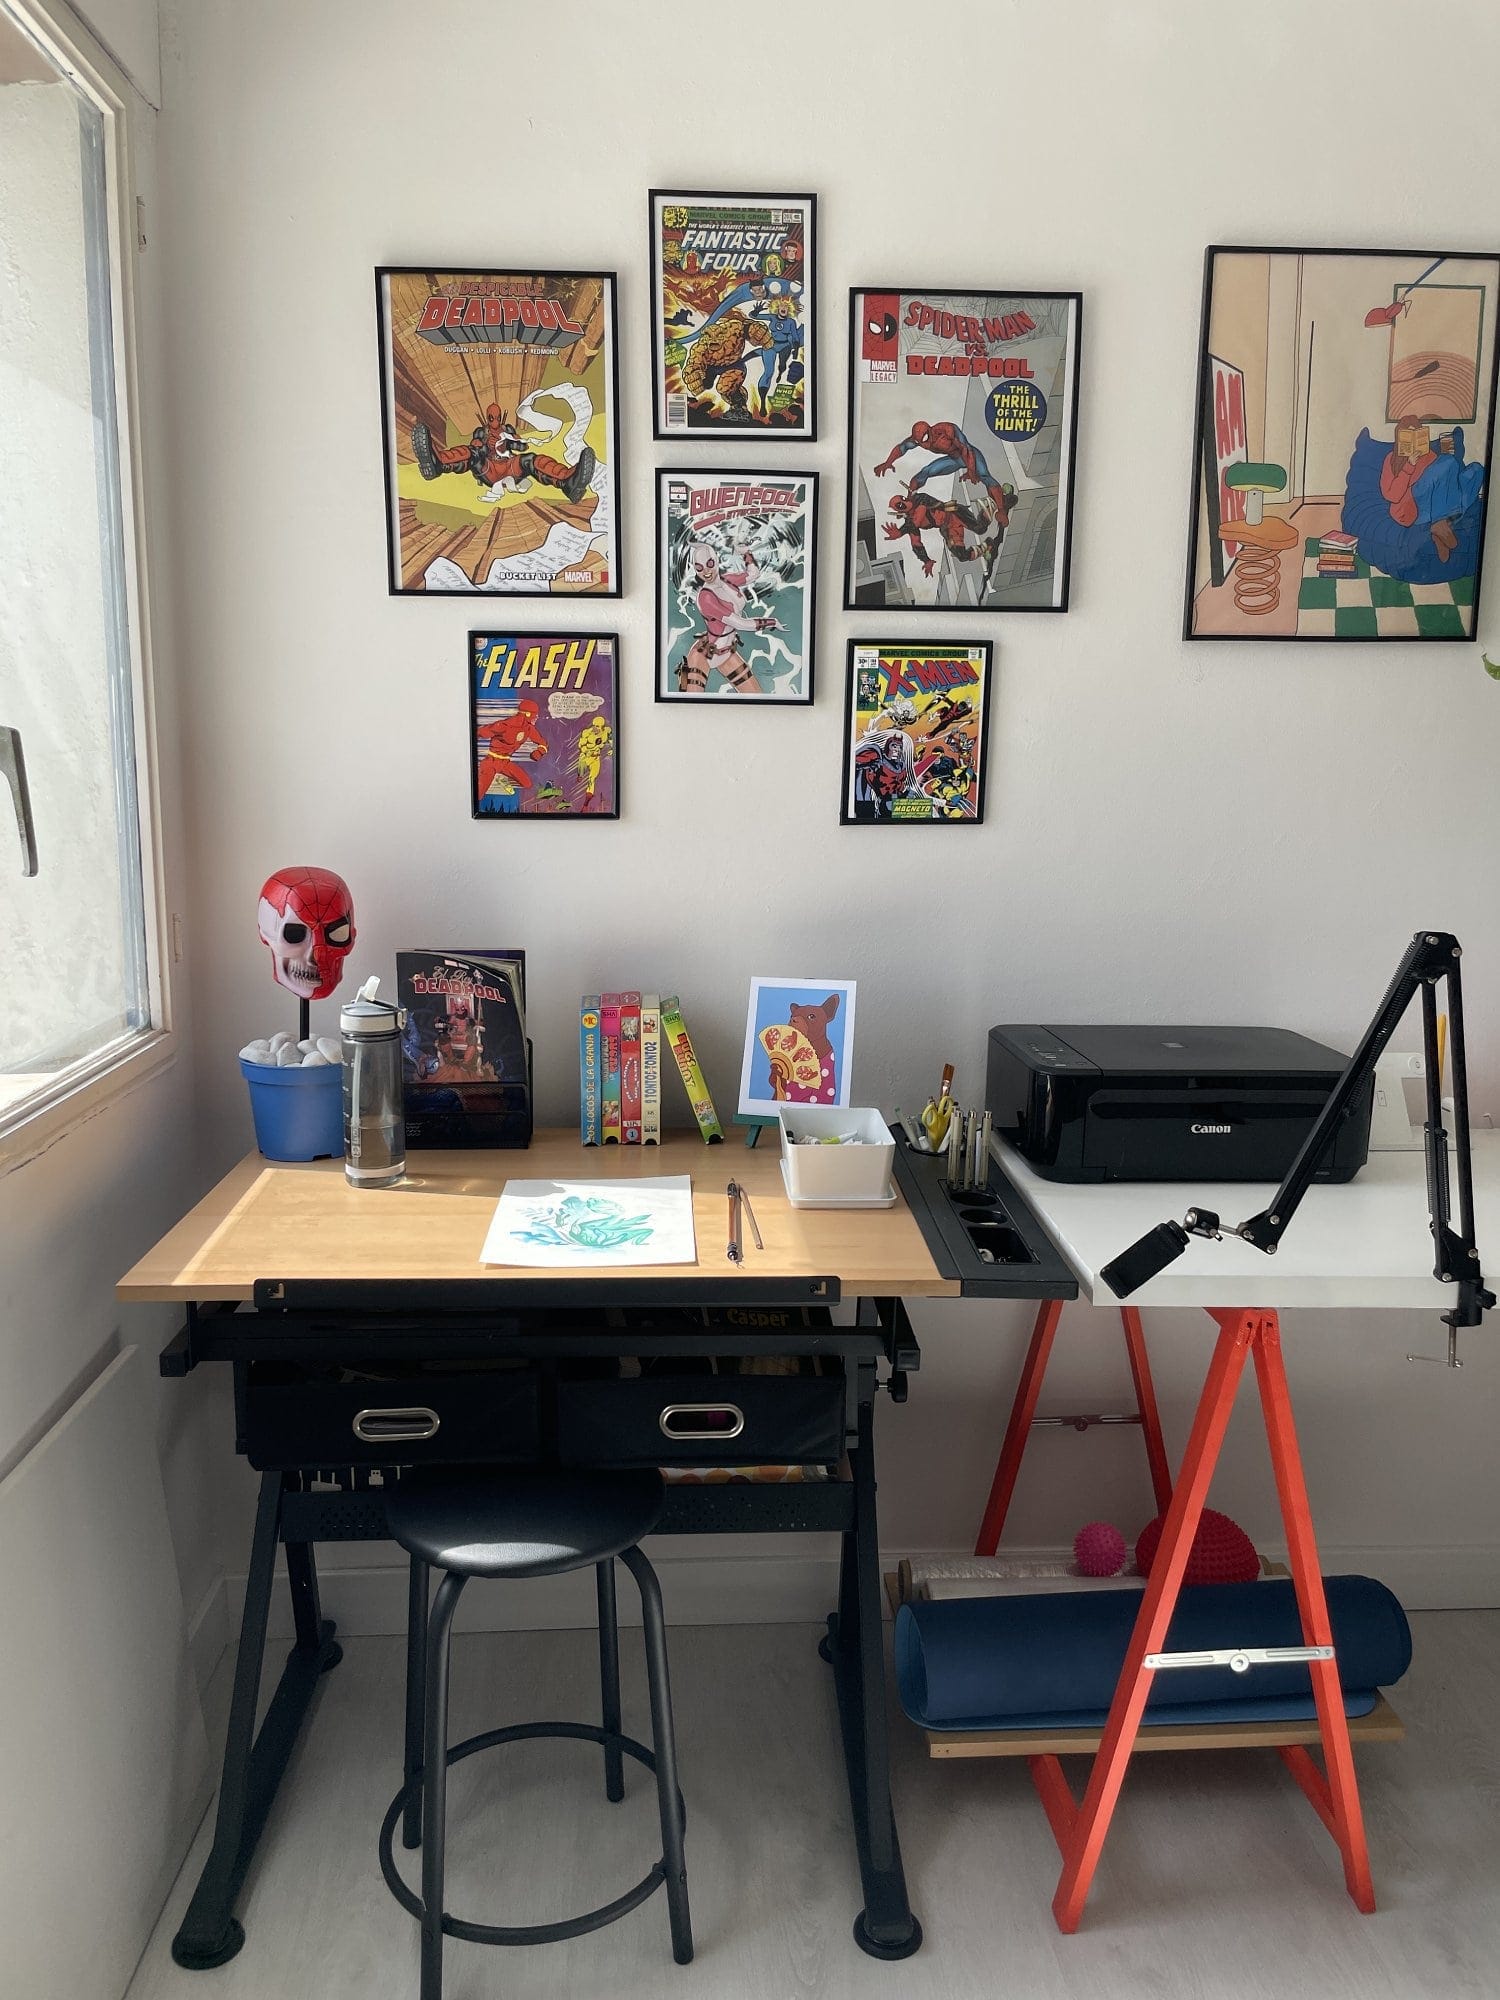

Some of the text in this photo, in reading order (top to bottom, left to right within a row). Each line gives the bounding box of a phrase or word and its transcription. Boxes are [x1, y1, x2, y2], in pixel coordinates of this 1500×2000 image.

[680, 229, 788, 251] FANTASTIC
[700, 251, 760, 272] FOUR
[459, 281, 544, 297] DESPICABLE
[415, 297, 585, 341] DEADPOOL
[904, 301, 1036, 343] SPIDER-MAN
[871, 360, 897, 371] MARVEL
[906, 355, 1034, 378] DEADPOOL
[871, 372, 897, 382] LEGACY
[993, 395, 1039, 409] THRILL
[997, 409, 1033, 418] OF THE
[689, 486, 801, 517] GWENPOOL
[500, 572, 558, 582] BUCKET LIST
[564, 571, 594, 583] MARVEL
[480, 639, 596, 688] FLASH
[878, 660, 980, 699] X-MEN
[414, 977, 507, 1004] DEADPOOL
[585, 1033, 595, 1067] GRANJA
[677, 1032, 697, 1067] BUGS
[586, 1068, 595, 1080] LA
[586, 1081, 595, 1093] DE
[586, 1095, 595, 1123] LOCOS
[1190, 1123, 1232, 1134] Canon
[726, 1308, 790, 1328] Casper
